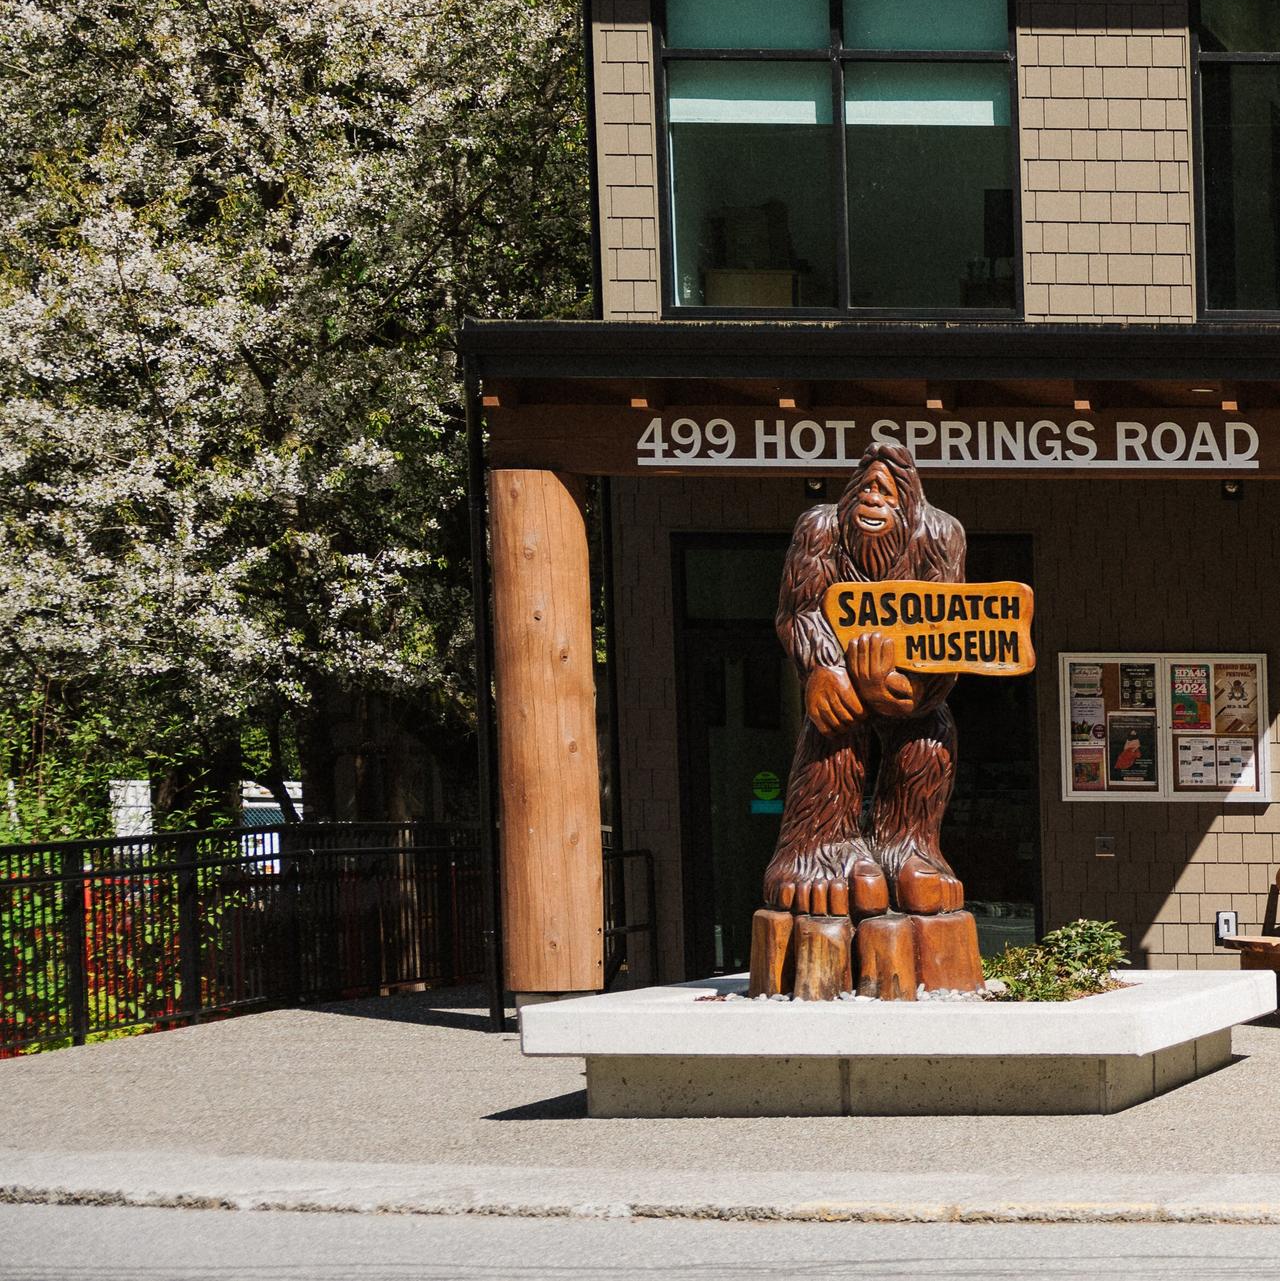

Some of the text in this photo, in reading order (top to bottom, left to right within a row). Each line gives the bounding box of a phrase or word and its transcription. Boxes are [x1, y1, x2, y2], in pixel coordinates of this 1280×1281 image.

[636, 417, 1260, 462] 499 HOT SPRINGS ROAD
[837, 590, 1021, 627] SASQUATCH
[905, 629, 1020, 663] MUSEUM
[1175, 683, 1207, 694] 2024
